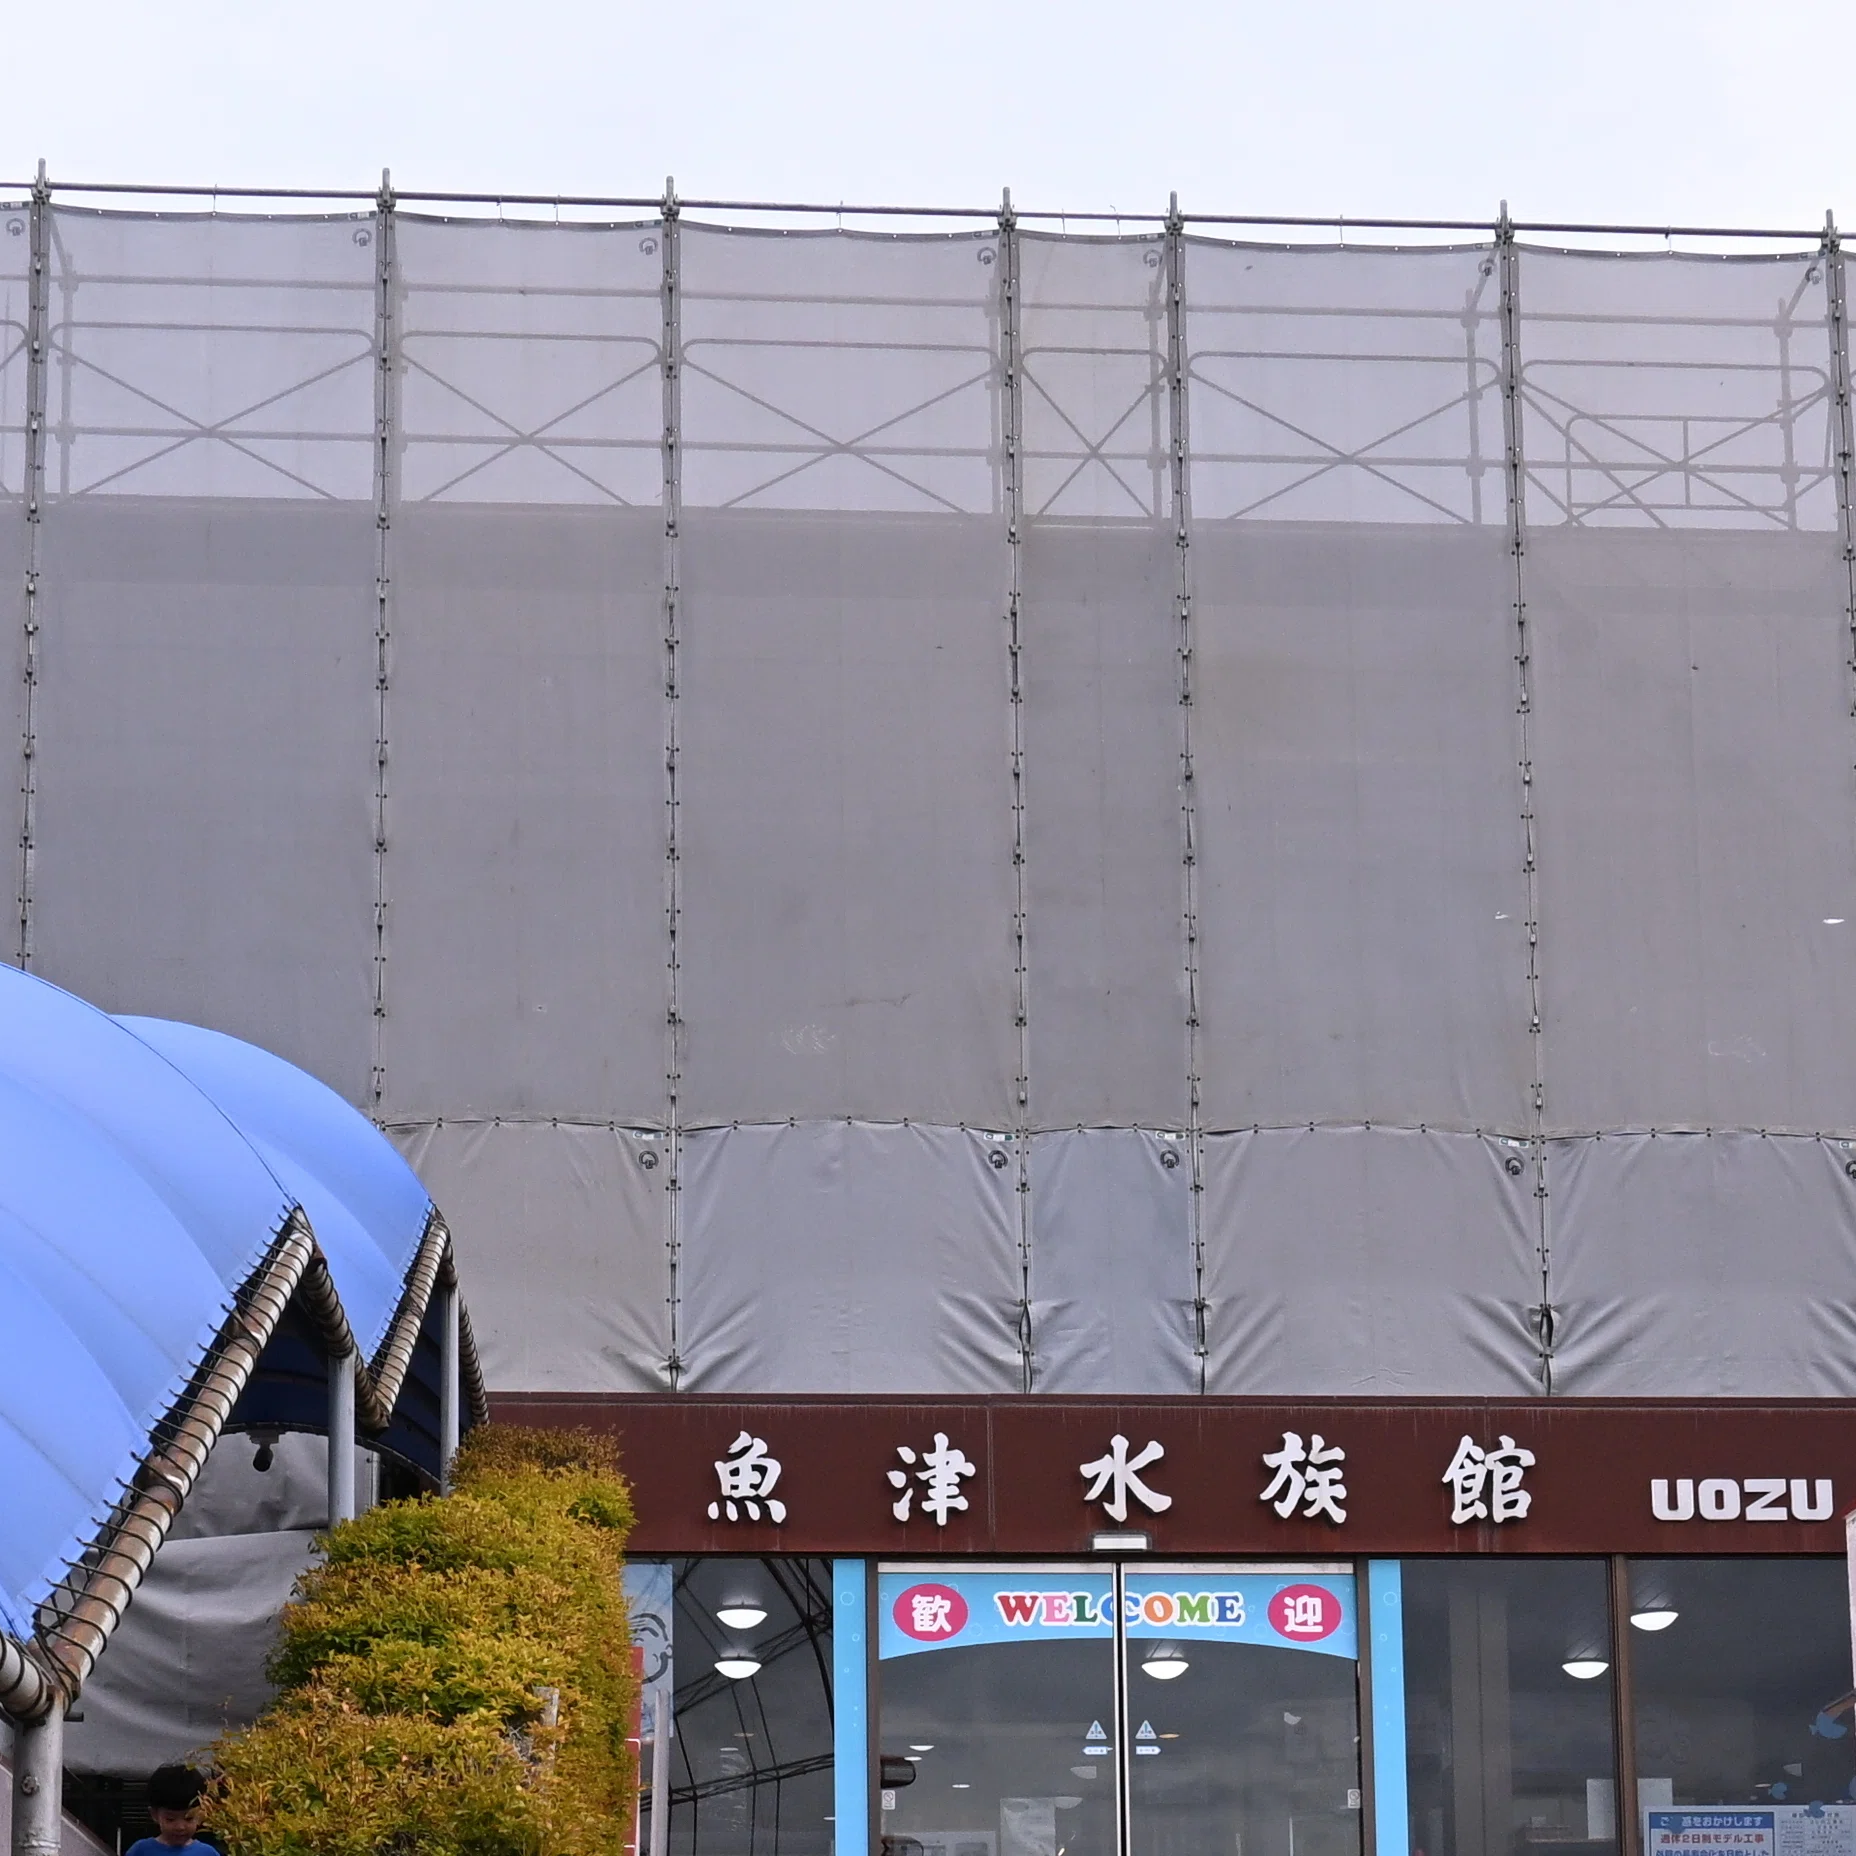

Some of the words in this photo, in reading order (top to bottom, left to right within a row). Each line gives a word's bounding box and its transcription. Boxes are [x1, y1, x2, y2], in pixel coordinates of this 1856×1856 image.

[706, 1430, 1536, 1526] 魚津水族館
[1650, 1478, 1834, 1522] UOZU
[910, 1593, 953, 1634] 歓
[996, 1593, 1244, 1625] WELCOME
[1282, 1594, 1324, 1634] 迎
[1660, 1816, 1763, 1828] ご惑をおかけします
